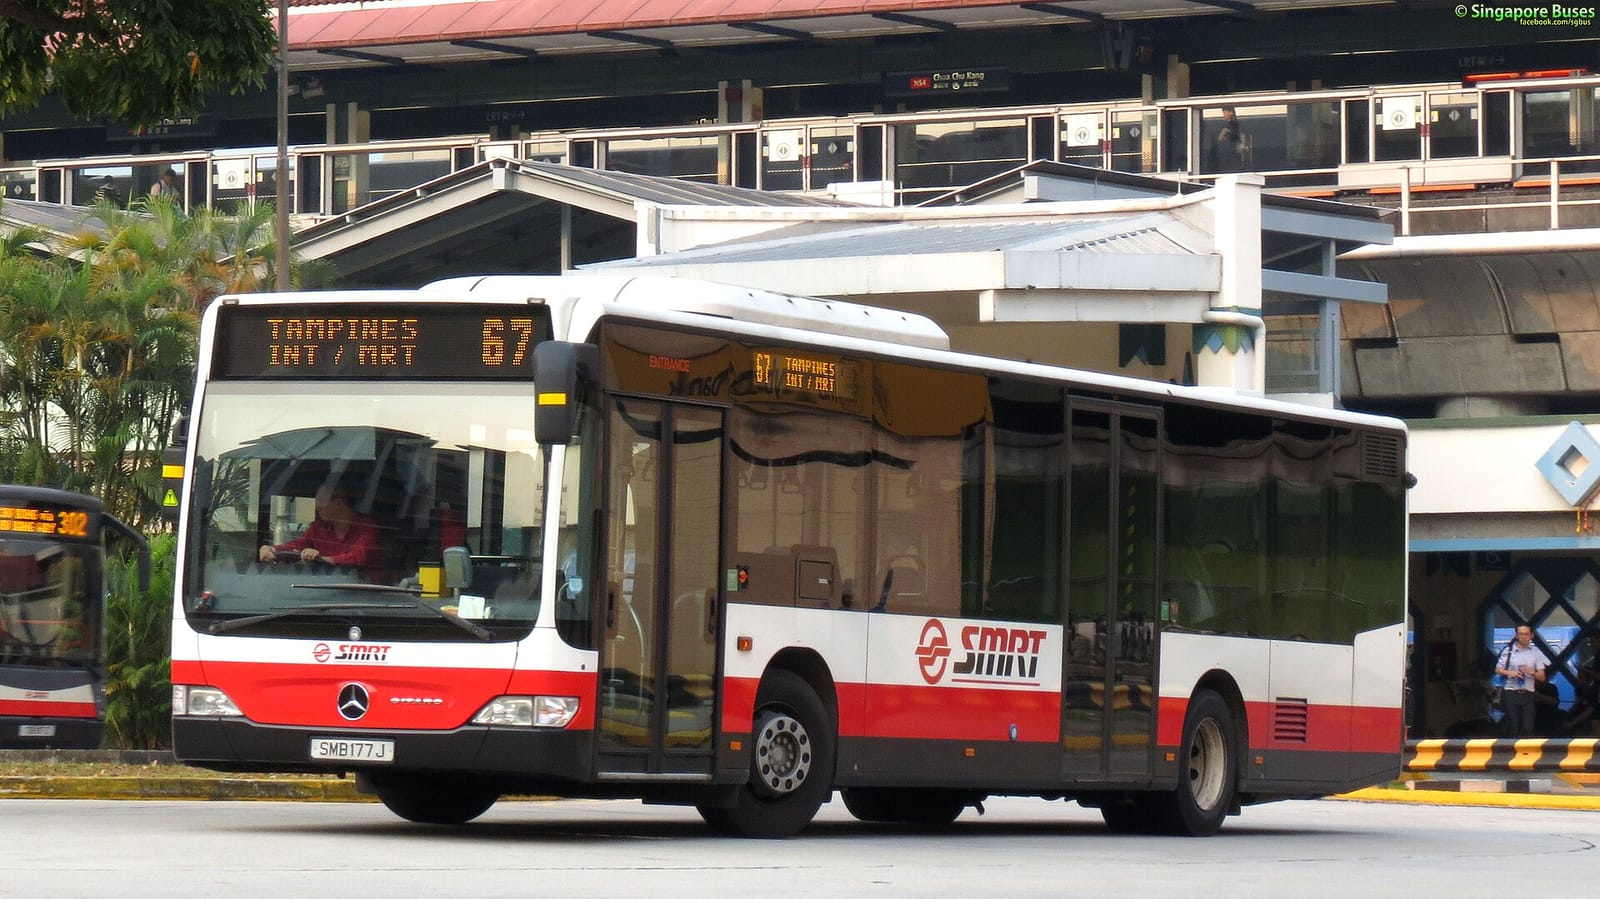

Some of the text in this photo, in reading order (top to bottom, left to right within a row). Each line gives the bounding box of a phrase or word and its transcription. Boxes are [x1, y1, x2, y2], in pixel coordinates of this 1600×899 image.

[913, 79, 927, 87] NS4
[933, 71, 985, 81] Chua Chu Kang
[267, 319, 418, 340] TAMPINES
[482, 319, 533, 366] 67
[269, 345, 416, 366] INT / MRT
[649, 355, 691, 373] ENTRANCE
[755, 353, 771, 384] 67
[785, 356, 836, 377] TAMPINES
[785, 373, 803, 389] INT
[814, 377, 835, 392] MRT
[57, 511, 88, 536] 302
[334, 644, 392, 661] SMRT
[952, 626, 1047, 678] SMRT
[319, 741, 385, 759] SMB177J
